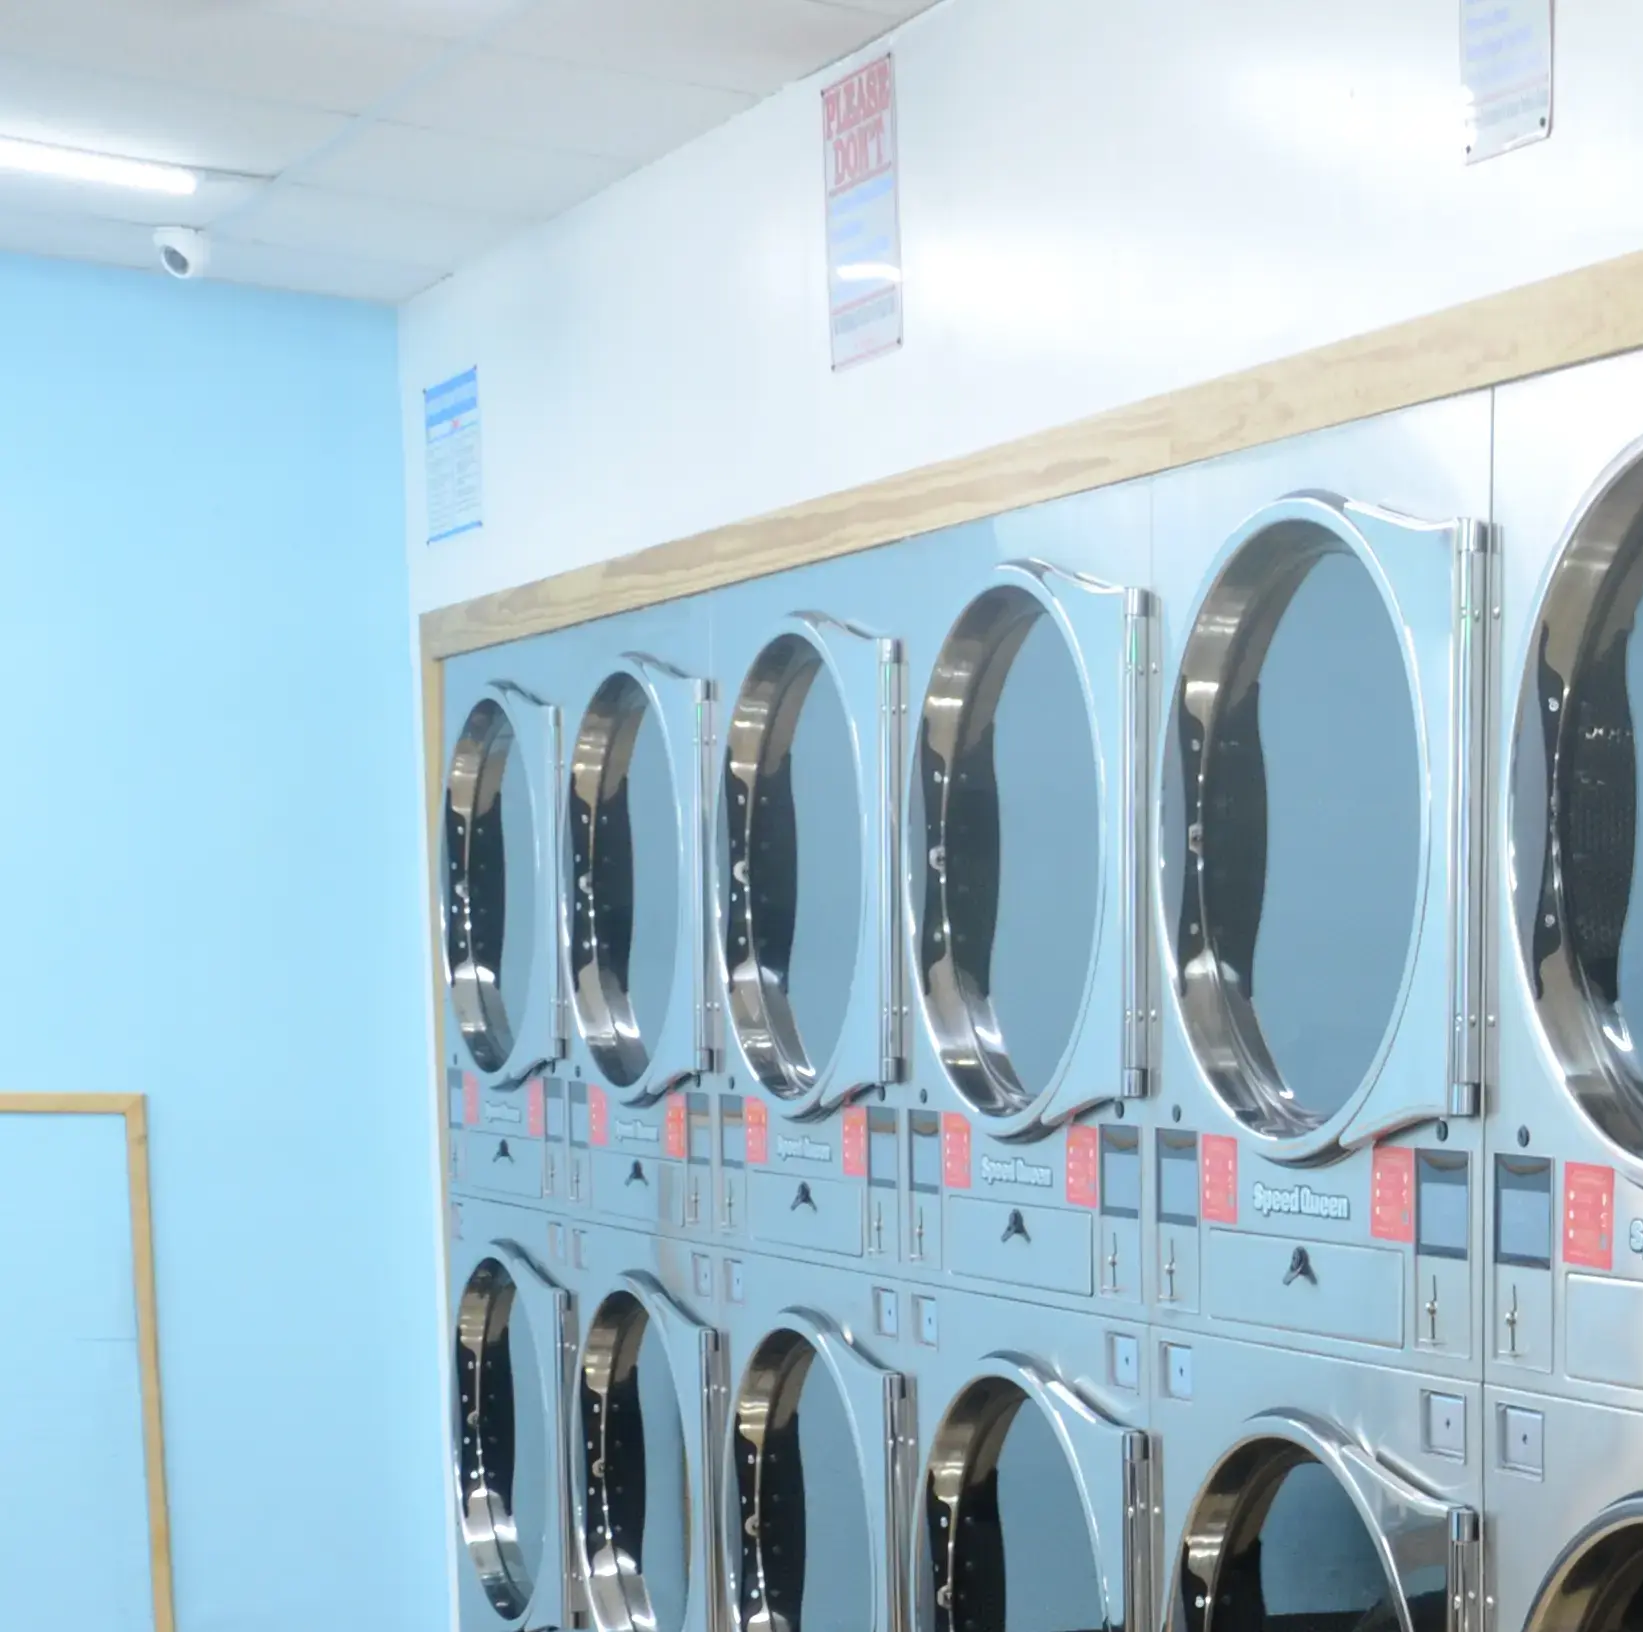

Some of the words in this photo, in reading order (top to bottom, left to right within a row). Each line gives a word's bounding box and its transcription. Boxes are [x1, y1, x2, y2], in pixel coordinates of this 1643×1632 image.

[826, 61, 890, 141] PLEASE
[1253, 1181, 1301, 1218] Speed
[1300, 1185, 1351, 1220] Queen
